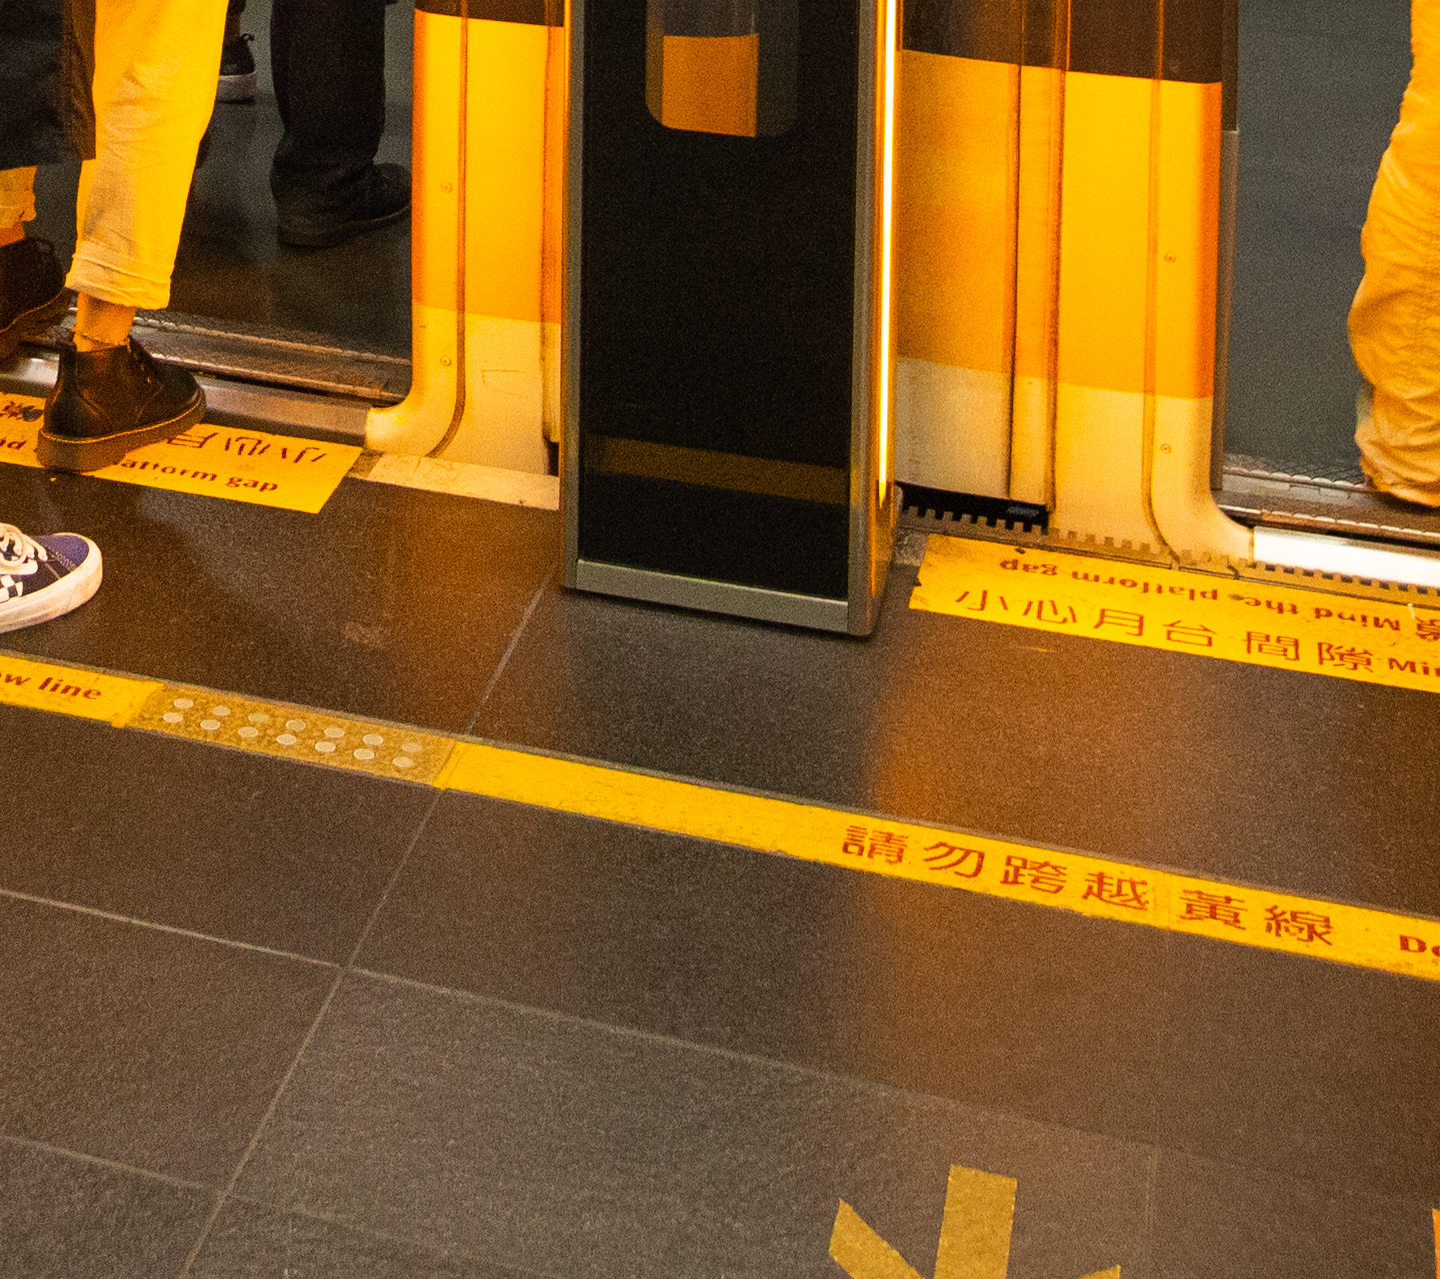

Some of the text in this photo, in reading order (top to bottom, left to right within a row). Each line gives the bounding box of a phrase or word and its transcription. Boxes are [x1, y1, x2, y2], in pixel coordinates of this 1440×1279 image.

[225, 475, 278, 493] gap
[999, 558, 1058, 577] gap
[1071, 569, 1218, 602] platform
[955, 588, 1374, 674] 小心月台間隙
[1314, 604, 1401, 633] Mind
[38, 676, 103, 700] line
[842, 825, 1335, 946] 請勿跨越黃線
